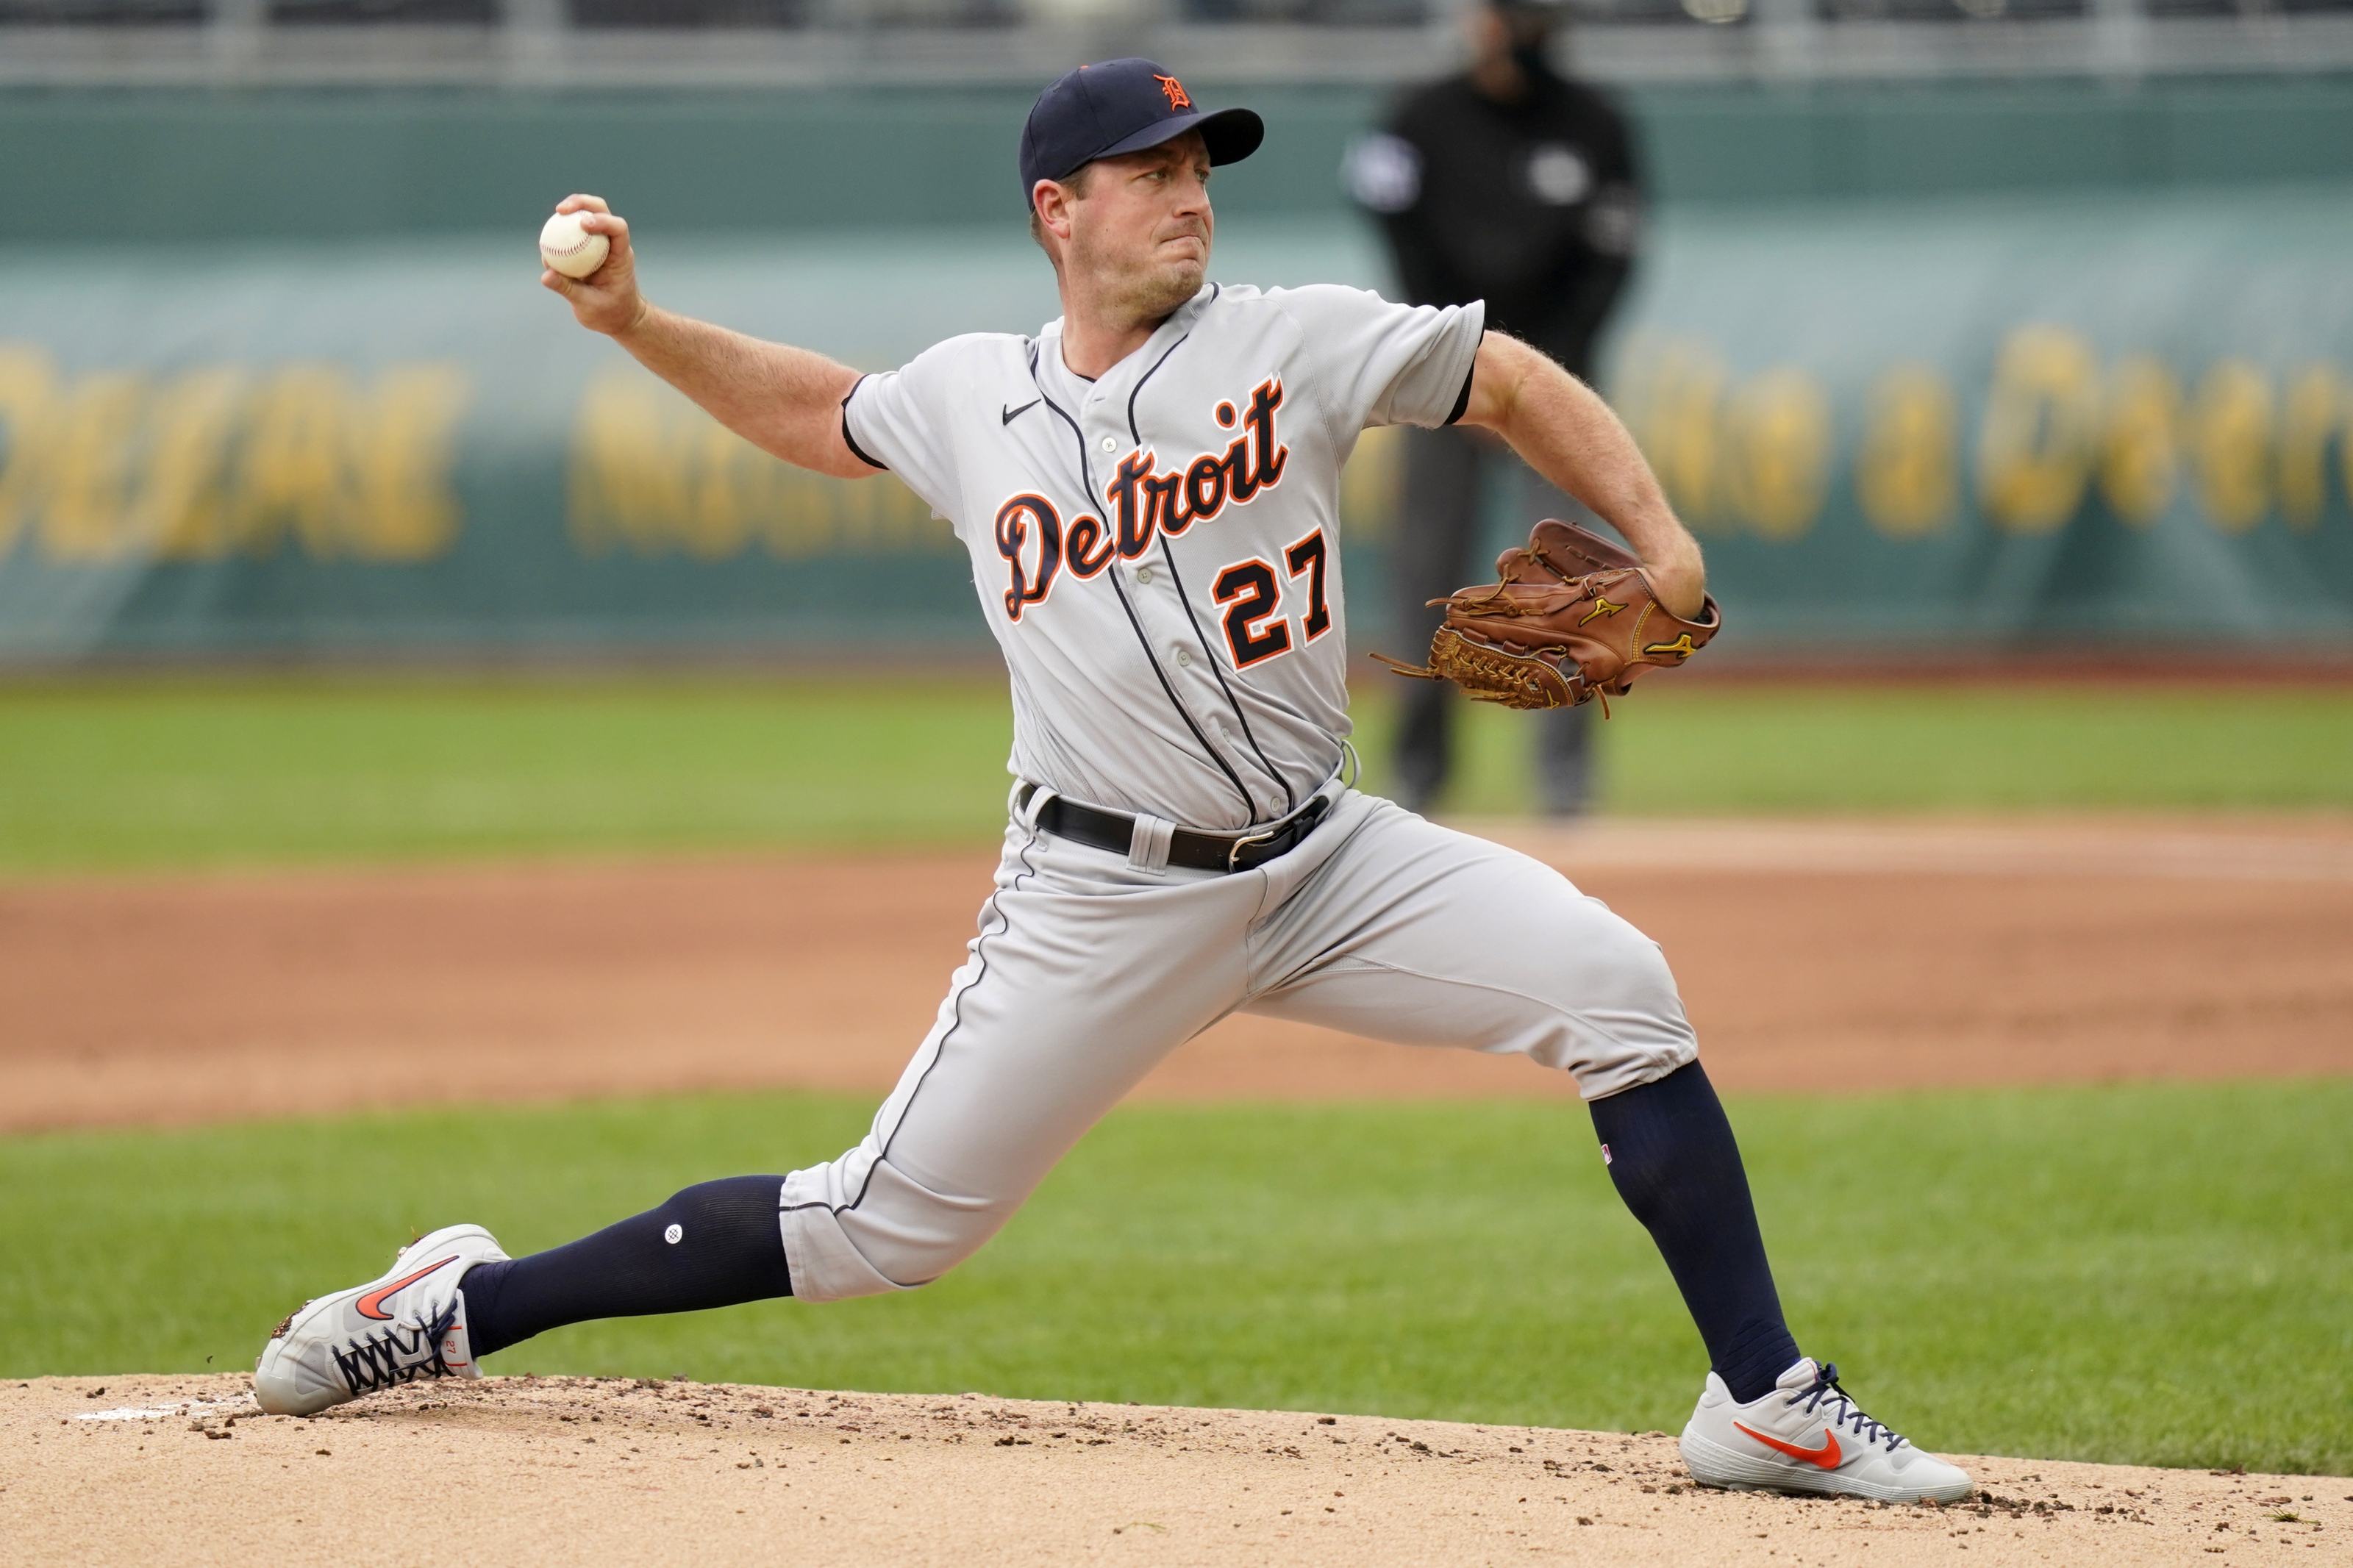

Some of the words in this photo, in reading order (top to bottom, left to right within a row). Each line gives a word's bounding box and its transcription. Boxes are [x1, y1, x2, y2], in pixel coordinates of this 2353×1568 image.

[1153, 74, 1191, 112] D
[993, 371, 1290, 626] Detroit
[1208, 523, 1333, 674] 27
[446, 1340, 457, 1354] 27
